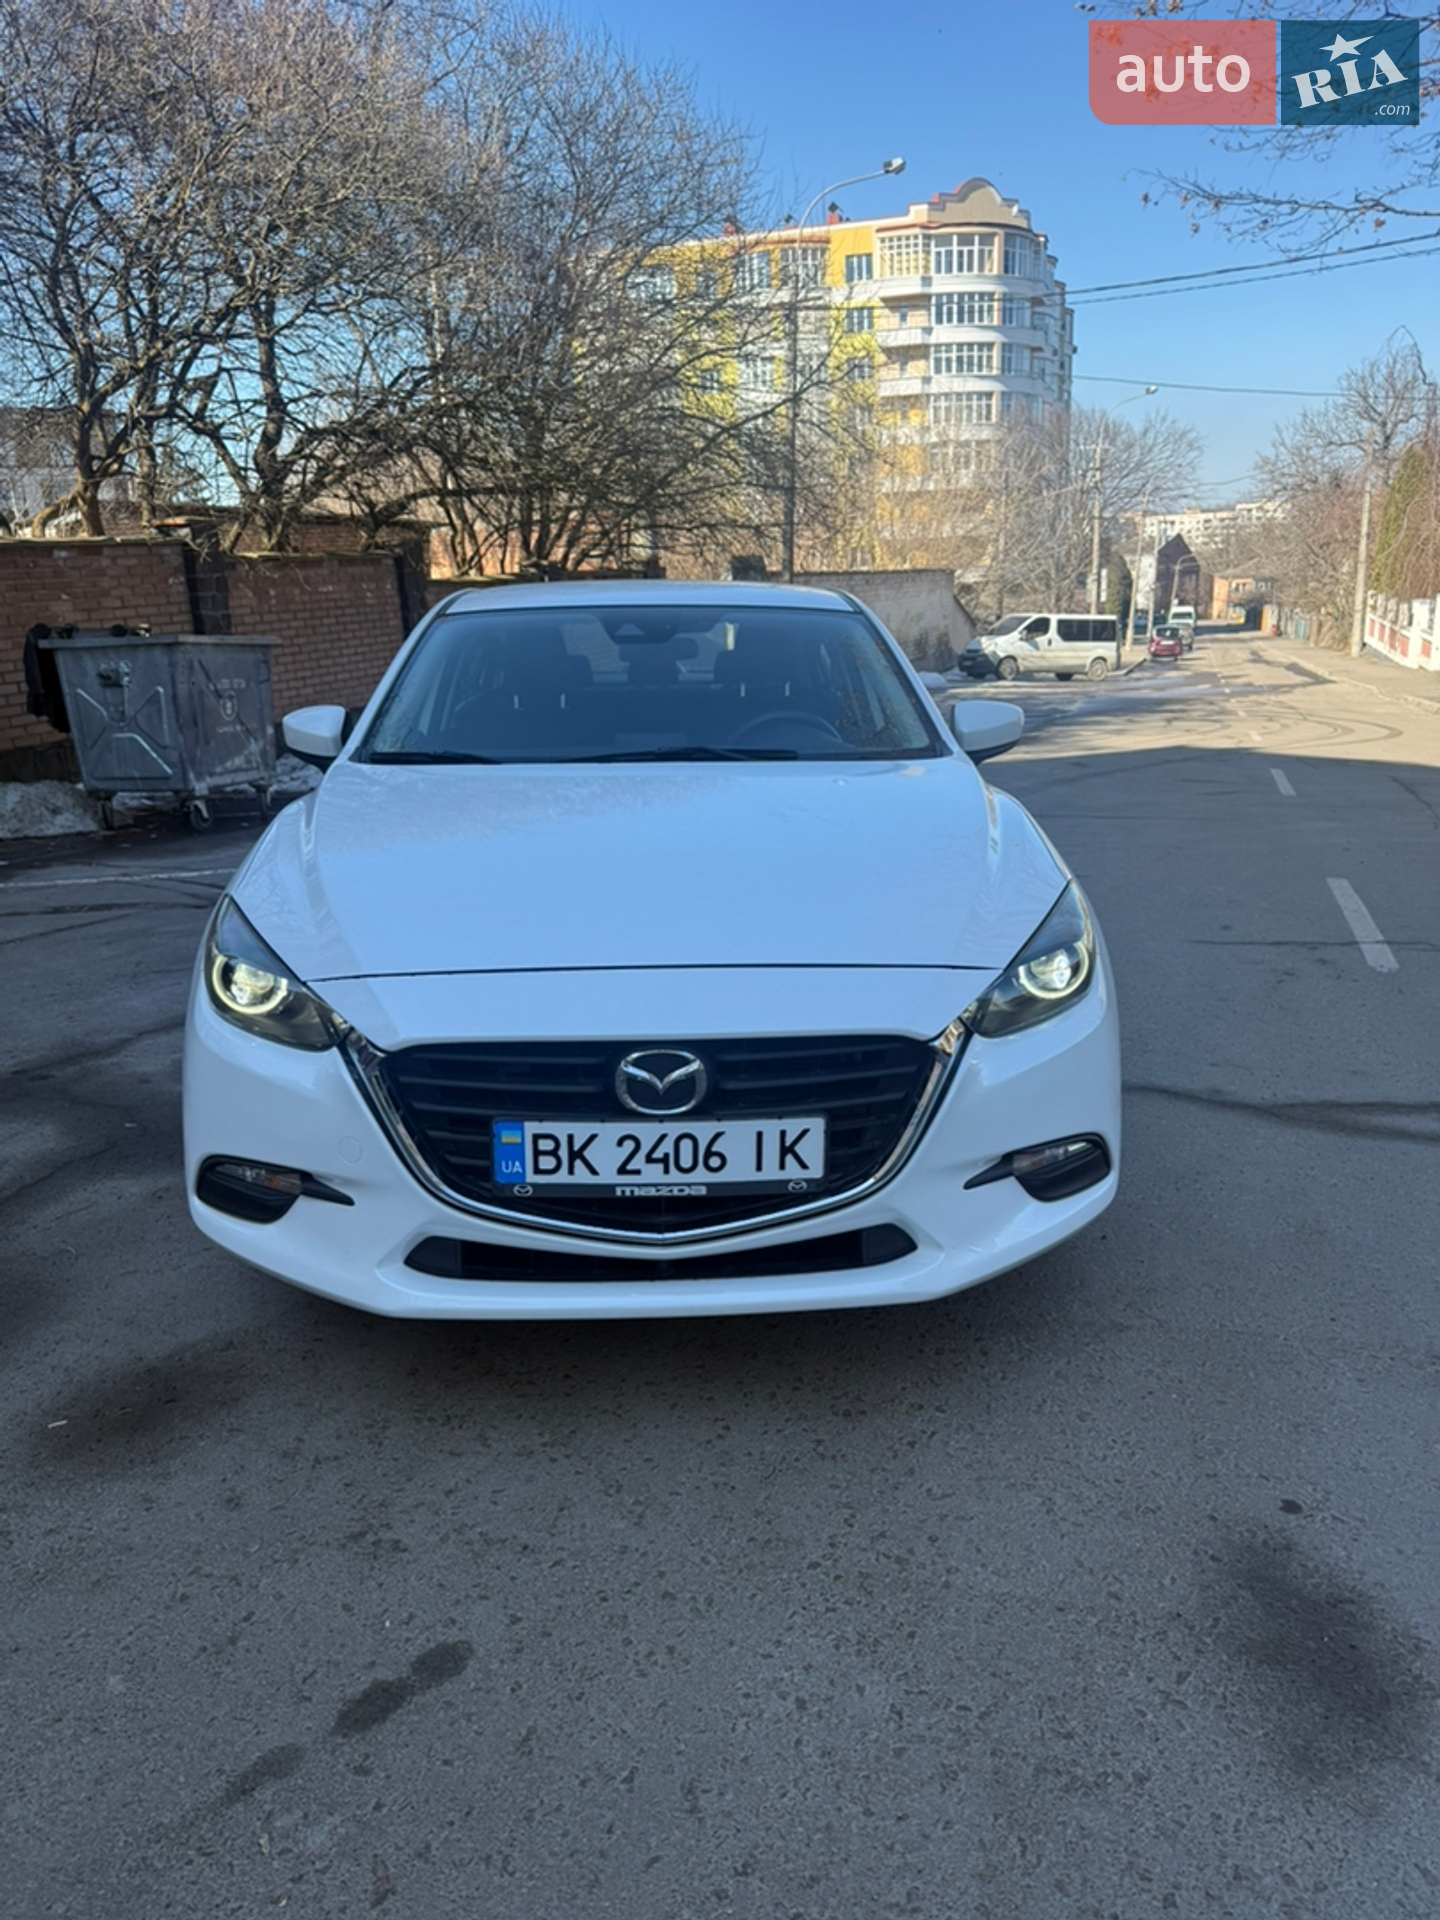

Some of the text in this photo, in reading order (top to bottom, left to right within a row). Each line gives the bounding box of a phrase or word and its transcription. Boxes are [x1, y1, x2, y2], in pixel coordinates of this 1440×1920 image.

[531, 1127, 811, 1176] BK 2406 IK
[501, 1160, 523, 1174] UA
[615, 1184, 708, 1197] mazda
